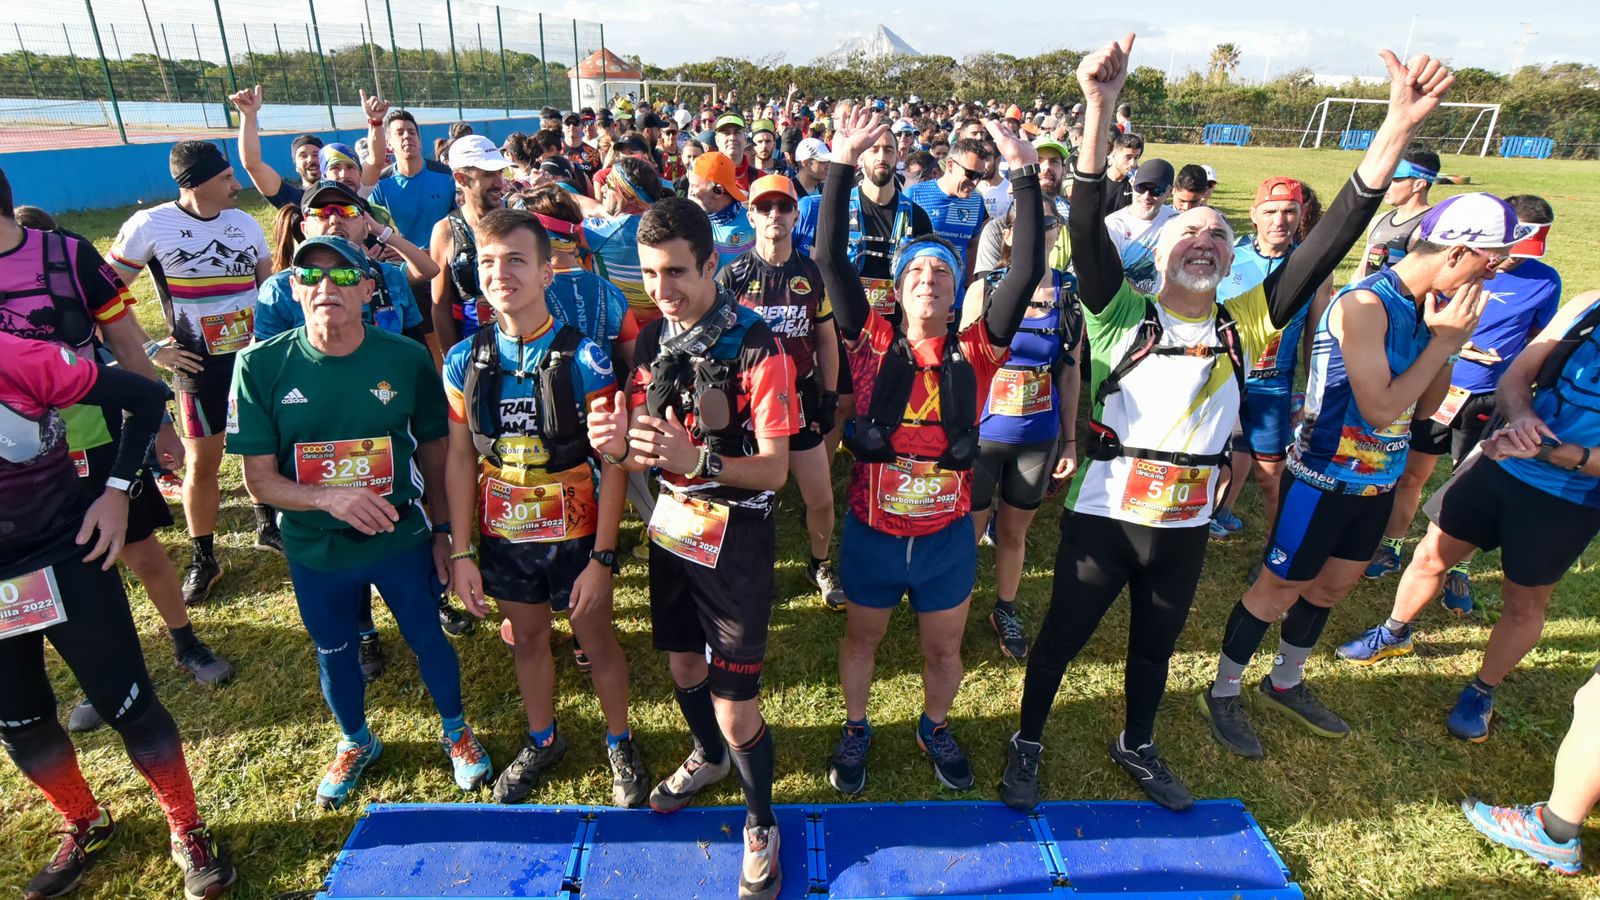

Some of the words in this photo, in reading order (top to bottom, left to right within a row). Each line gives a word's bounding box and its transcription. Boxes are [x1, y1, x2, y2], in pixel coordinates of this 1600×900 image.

[864, 287, 887, 301] 362
[753, 305, 807, 320] SIERRA
[220, 320, 248, 337] 411
[1006, 382, 1039, 399] 329
[321, 458, 371, 478] 328
[370, 476, 392, 486] 2022
[897, 474, 941, 496] 285
[885, 494, 935, 505] Carbonerilla
[936, 493, 955, 503] 2022
[1146, 481, 1190, 502] 510
[502, 501, 541, 520] 301
[1129, 498, 1183, 512] Carbonerilla
[491, 519, 540, 531] Carbonerilla
[542, 518, 564, 528] 2022
[698, 541, 720, 554] 2022
[22, 598, 54, 613] 2022
